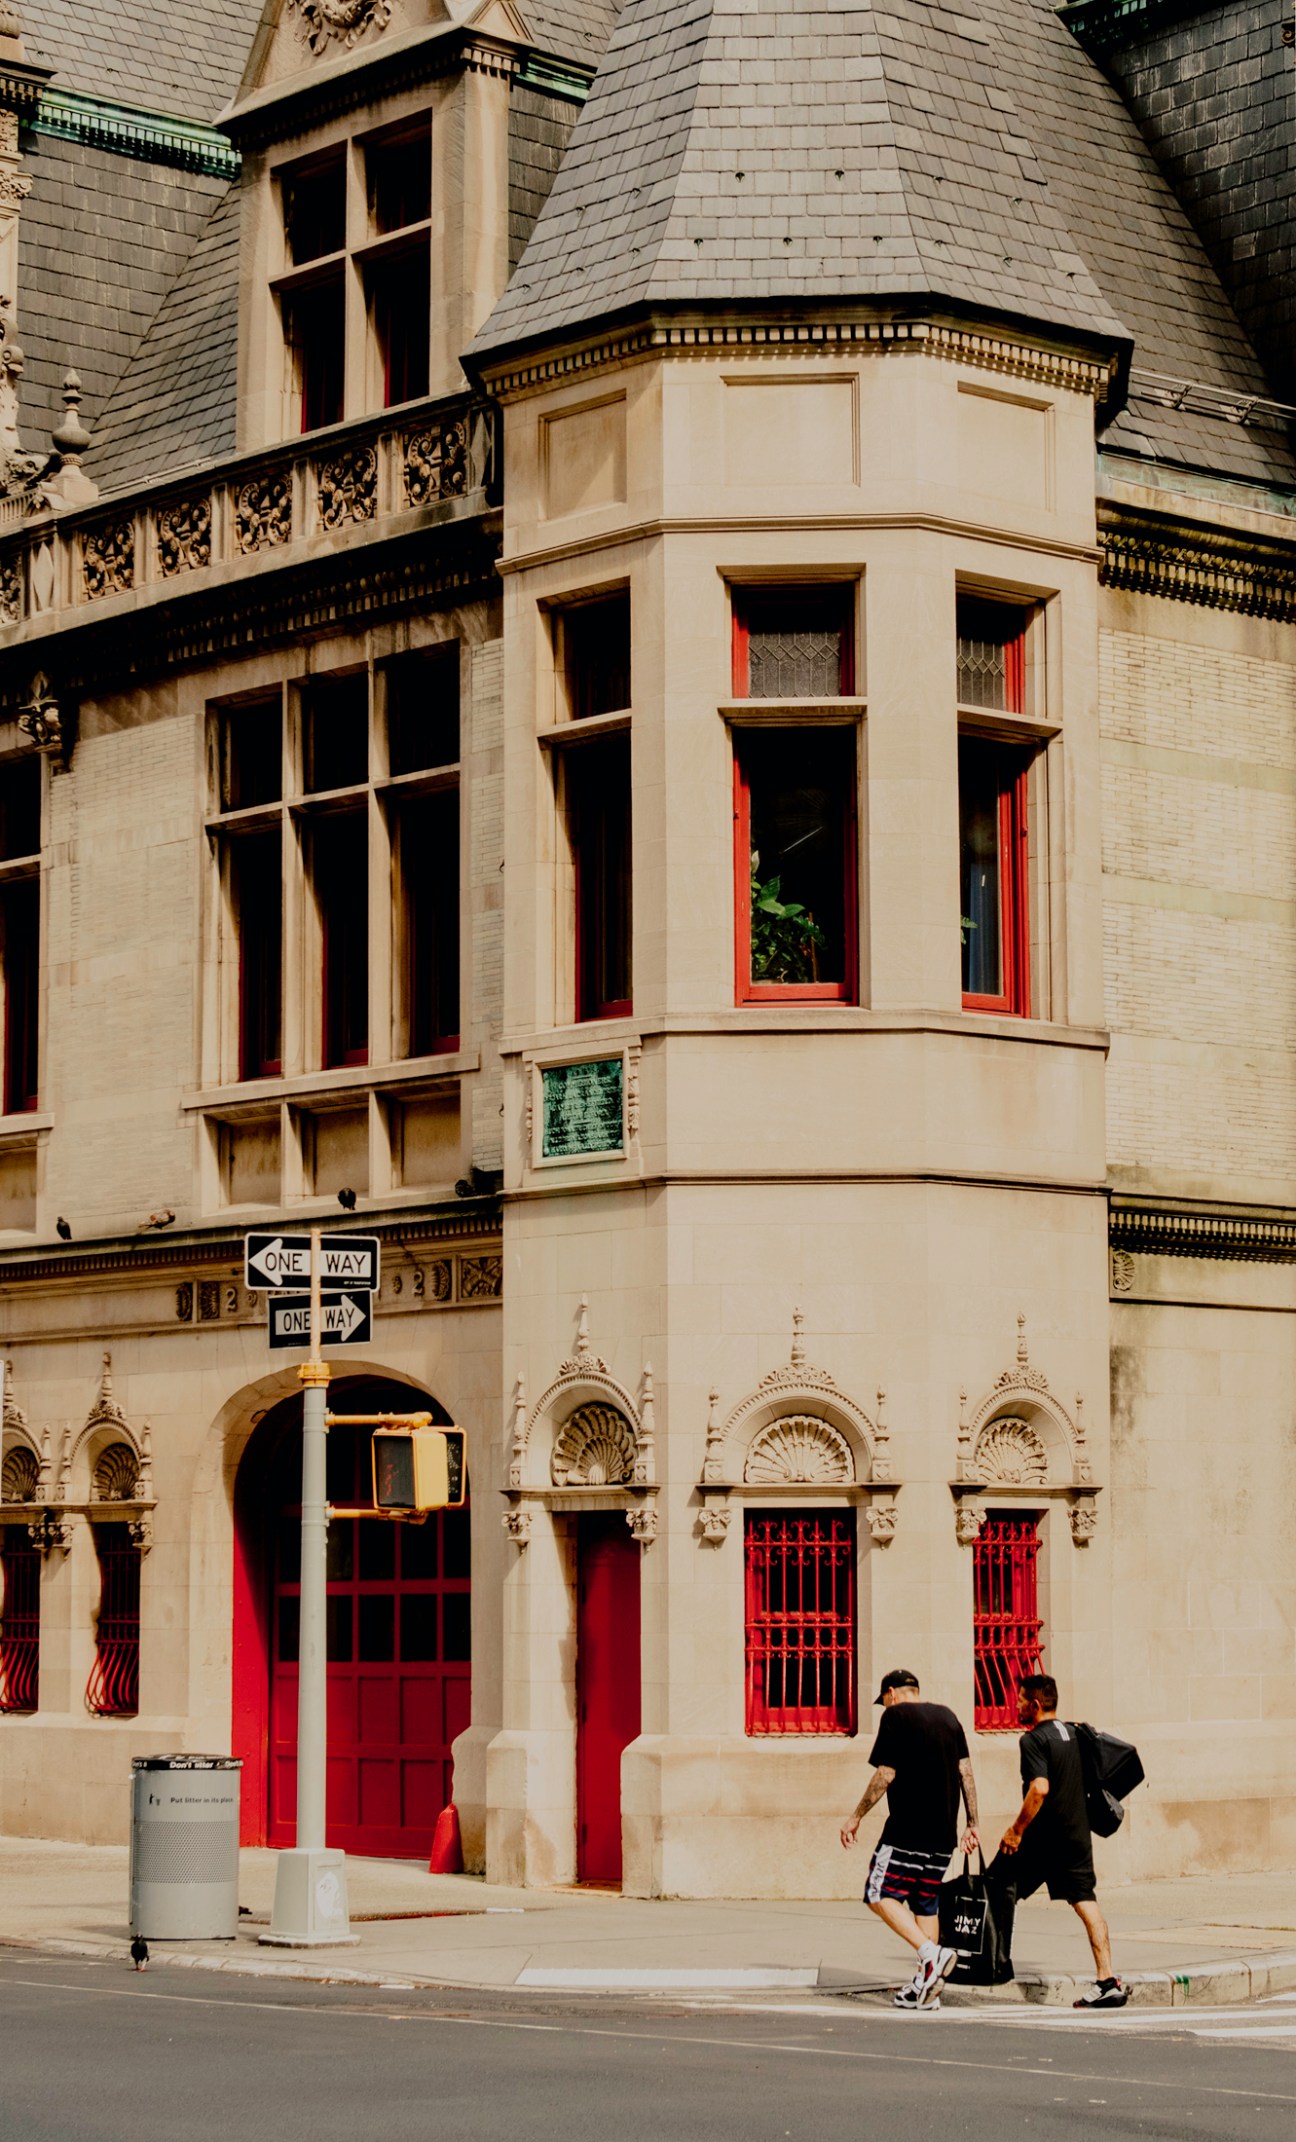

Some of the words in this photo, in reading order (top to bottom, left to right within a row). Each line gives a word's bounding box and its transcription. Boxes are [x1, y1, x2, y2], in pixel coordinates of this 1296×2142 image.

[265, 1252, 303, 1272] ONE
[326, 1254, 367, 1273] WAY
[225, 1288, 237, 1310] 2
[283, 1311, 311, 1332] ONE
[325, 1308, 356, 1329] WAY
